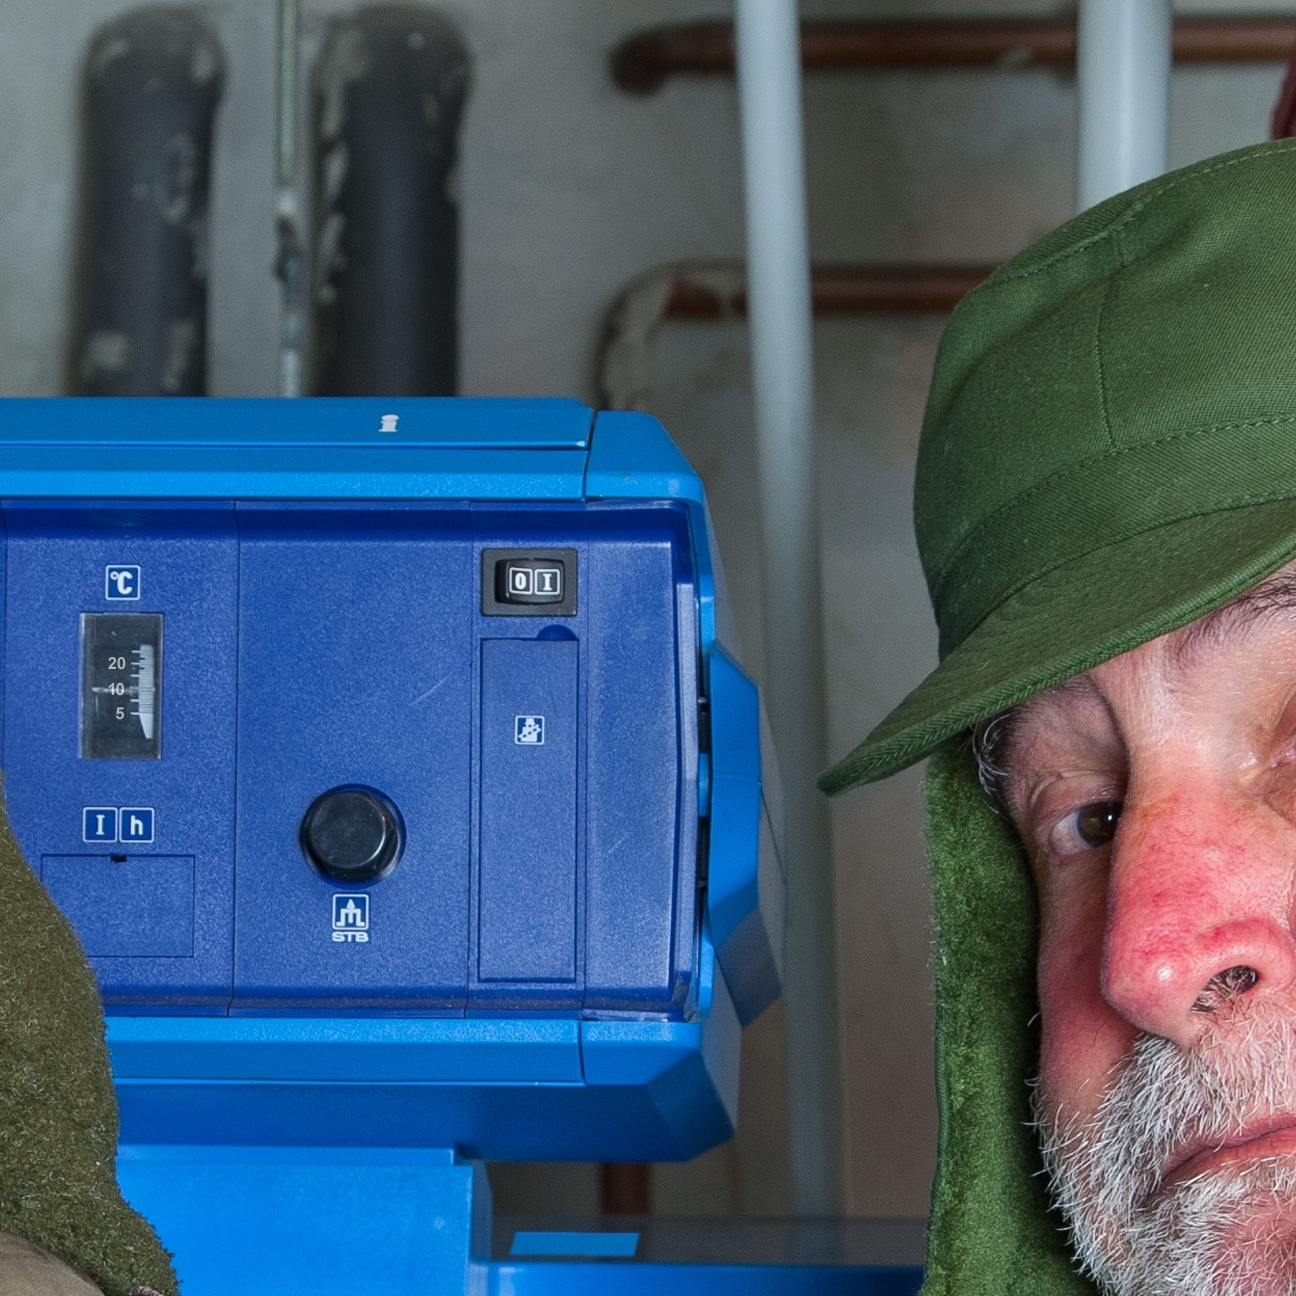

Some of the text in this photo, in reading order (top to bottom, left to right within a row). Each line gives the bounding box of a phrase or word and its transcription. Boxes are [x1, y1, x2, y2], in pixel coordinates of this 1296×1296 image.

[108, 656, 126, 670] 20
[108, 682, 125, 696] 10
[115, 707, 125, 720] 5
[332, 931, 369, 942] STB
